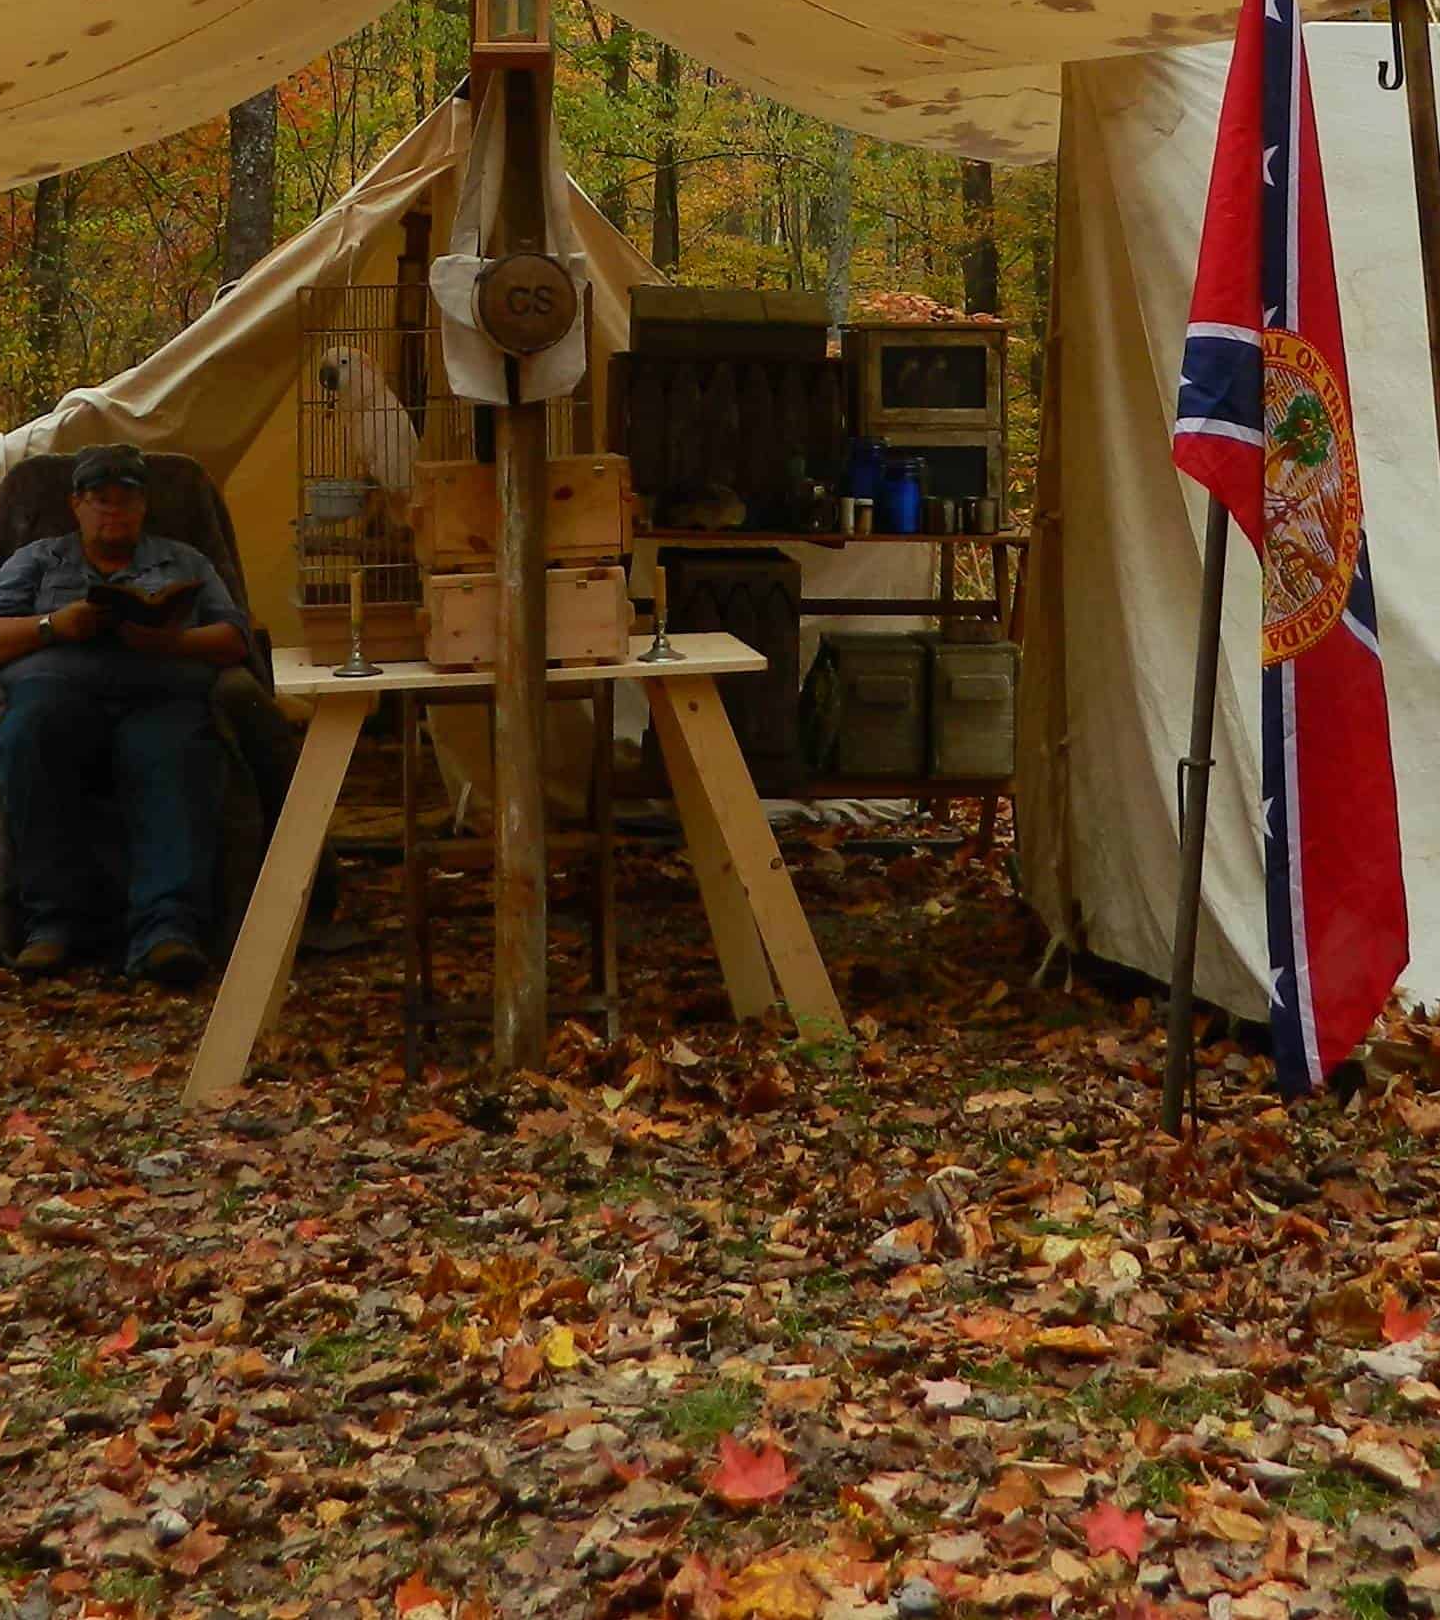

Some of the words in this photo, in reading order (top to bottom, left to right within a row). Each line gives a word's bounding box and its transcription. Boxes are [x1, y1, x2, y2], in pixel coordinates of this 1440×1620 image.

[1264, 336, 1288, 359] AL
[1295, 347, 1323, 378] OF
[1322, 377, 1350, 434] THE
[1342, 439, 1359, 520] STATE
[1342, 530, 1357, 565] OF
[1267, 574, 1346, 653] FLORIDA
